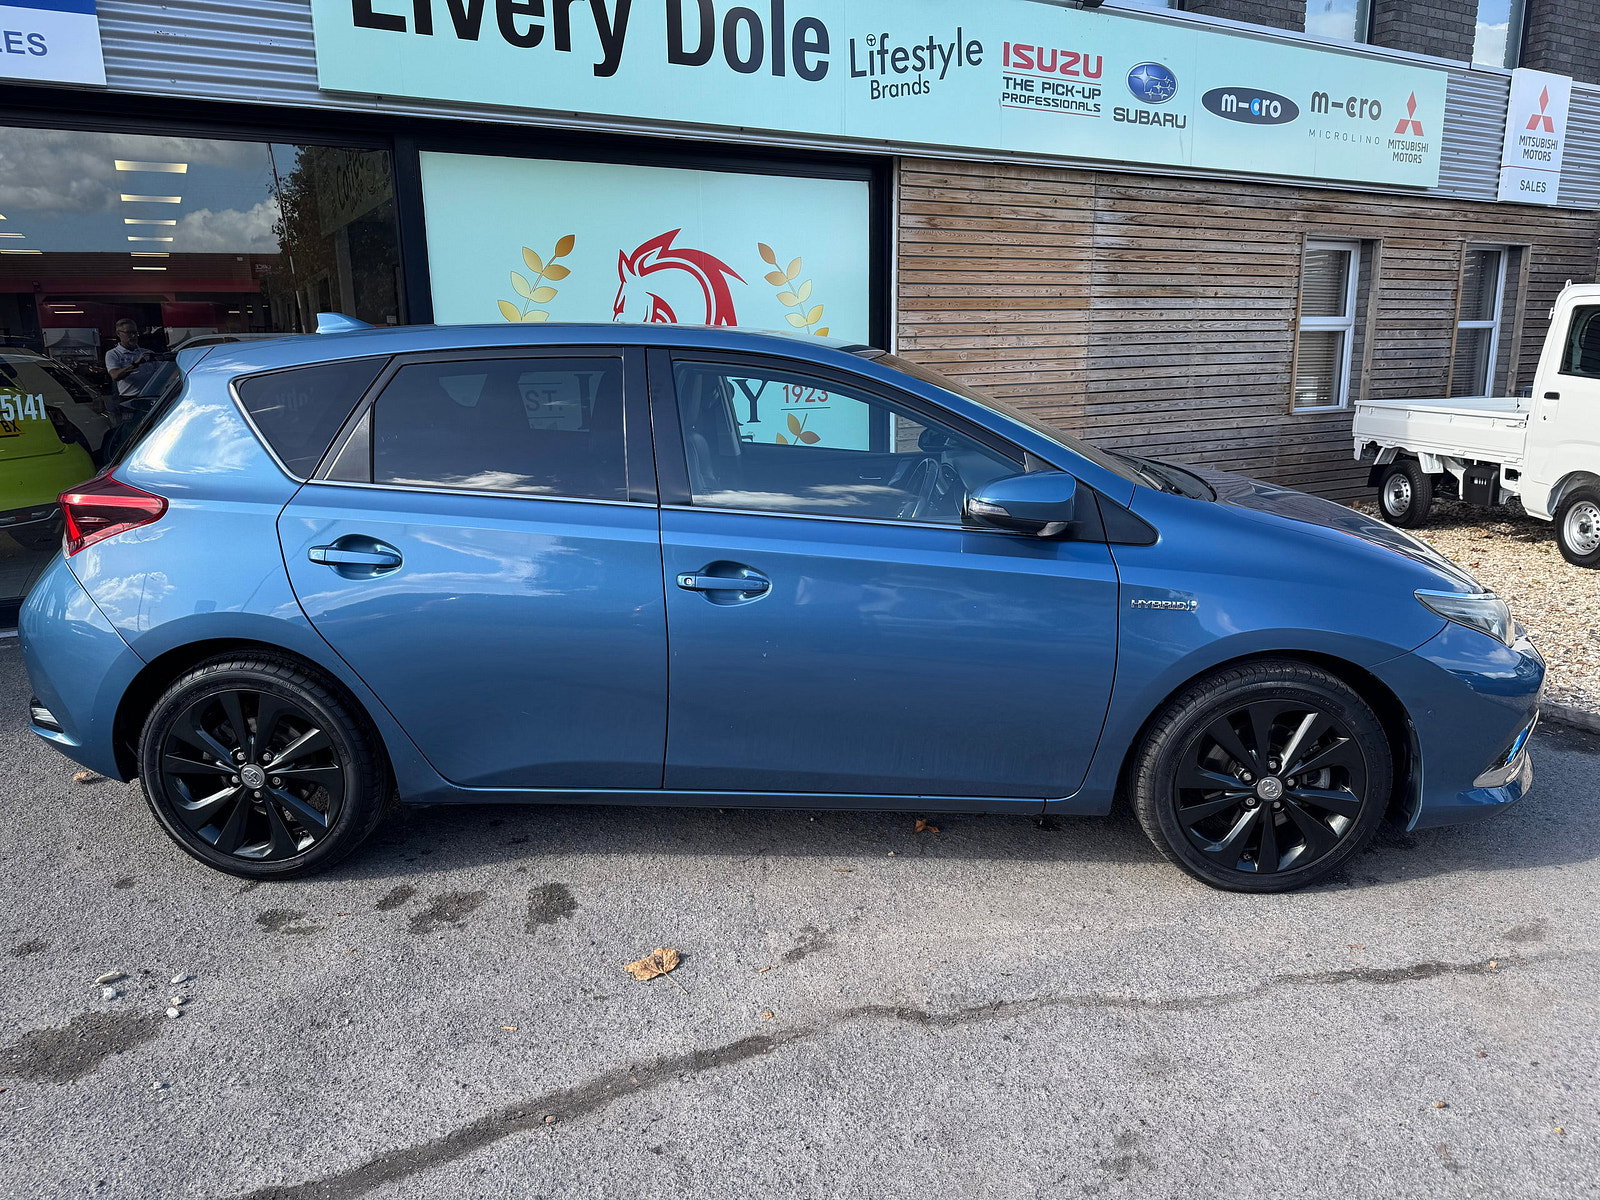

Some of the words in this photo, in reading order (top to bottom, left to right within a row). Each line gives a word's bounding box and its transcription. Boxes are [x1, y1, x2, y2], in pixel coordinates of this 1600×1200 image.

[0, 31, 48, 56] ES
[664, 0, 830, 82] Dole
[850, 27, 983, 80] Lifestyle
[1003, 41, 1103, 79] ISUZU
[870, 74, 930, 100] Brands
[1002, 76, 1035, 92] THE
[1041, 81, 1102, 100] PICK-UP
[1002, 92, 1101, 113] PROFESSIONALS
[1113, 107, 1187, 129] SUBARU
[1308, 129, 1381, 145] MICROLINO
[1387, 138, 1429, 153] MITSUBISHI
[1518, 135, 1559, 151] MITSUBISHI
[1392, 152, 1422, 164] MOTORS
[1522, 149, 1552, 162] MOTORS
[1519, 179, 1547, 193] SALES
[782, 384, 829, 403] 1923
[1131, 599, 1187, 611] HYBRID
